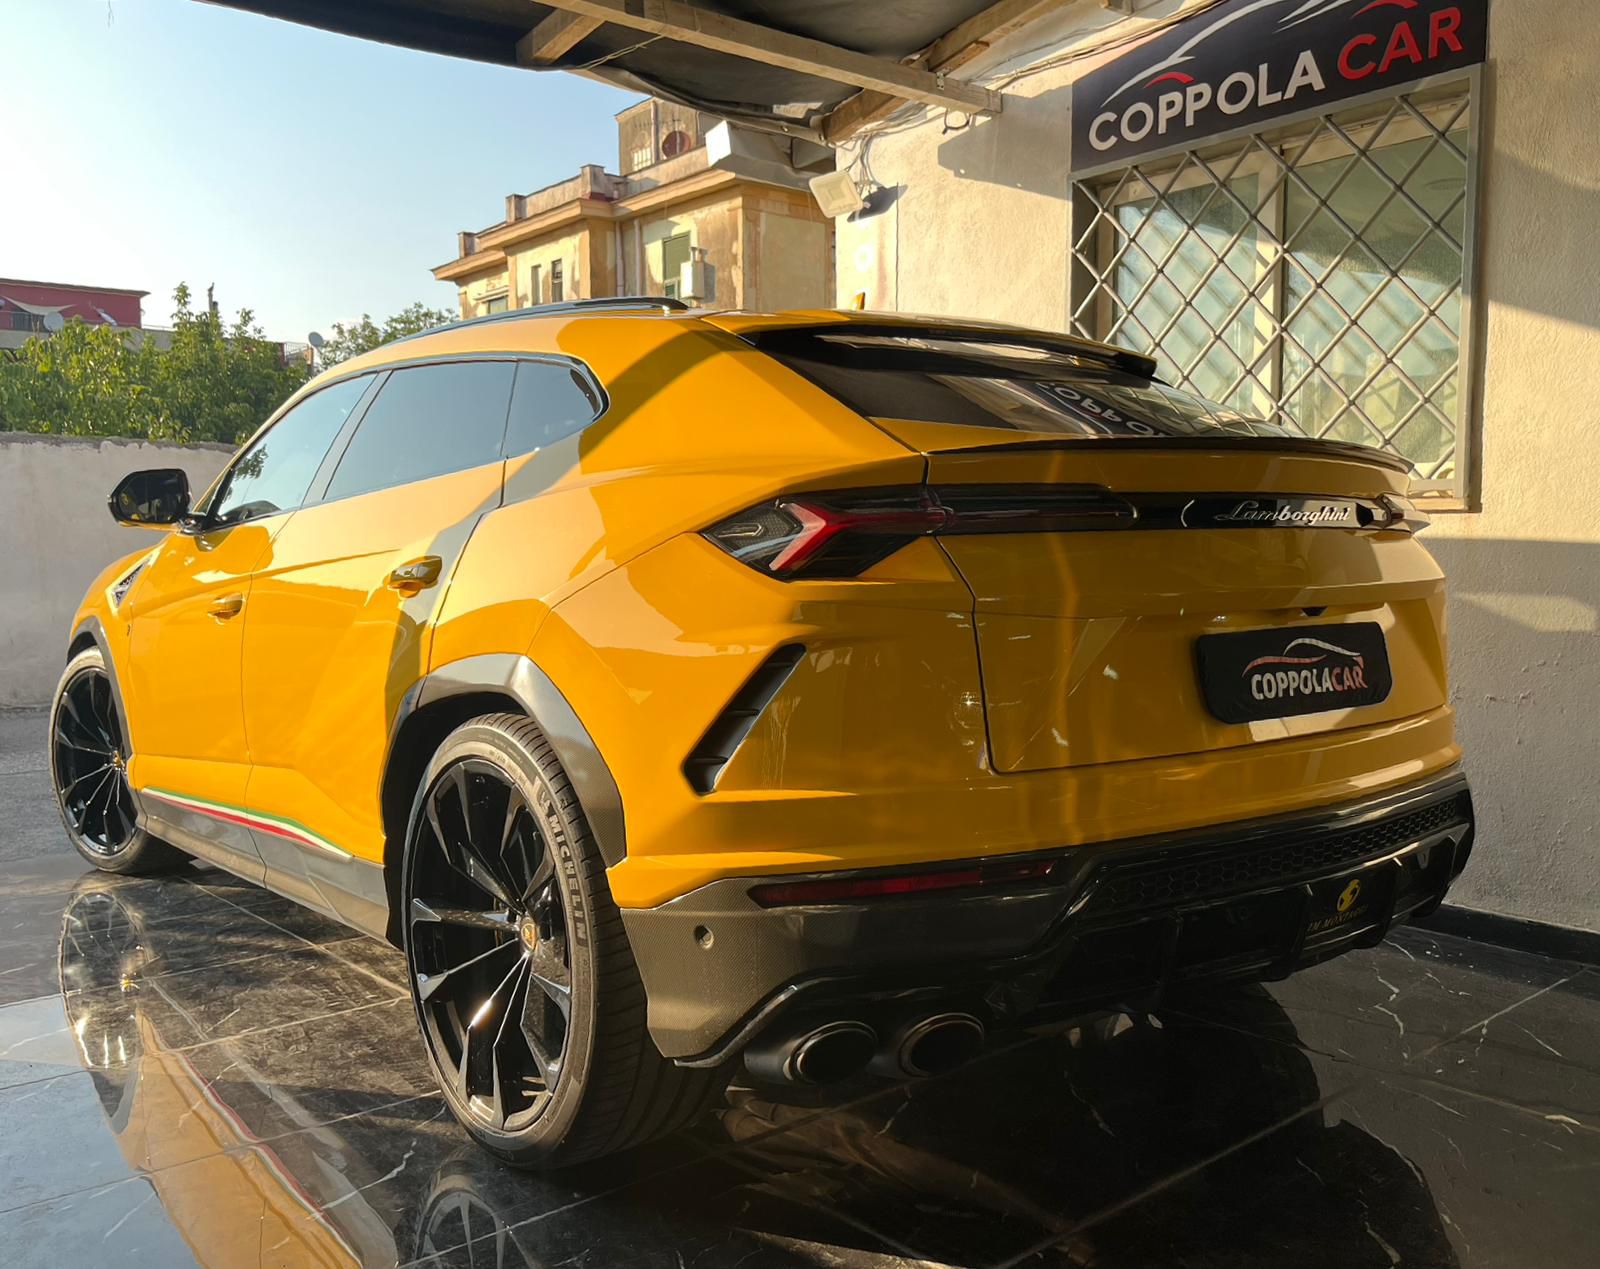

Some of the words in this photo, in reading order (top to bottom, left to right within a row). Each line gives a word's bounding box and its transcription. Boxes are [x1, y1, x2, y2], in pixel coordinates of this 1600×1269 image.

[1088, 49, 1325, 151] COPPOLA
[1337, 6, 1464, 80] CAR
[1213, 500, 1351, 526] Lamborghini
[1251, 666, 1368, 701] COPPOLACAR
[548, 813, 588, 941] MICHELIN
